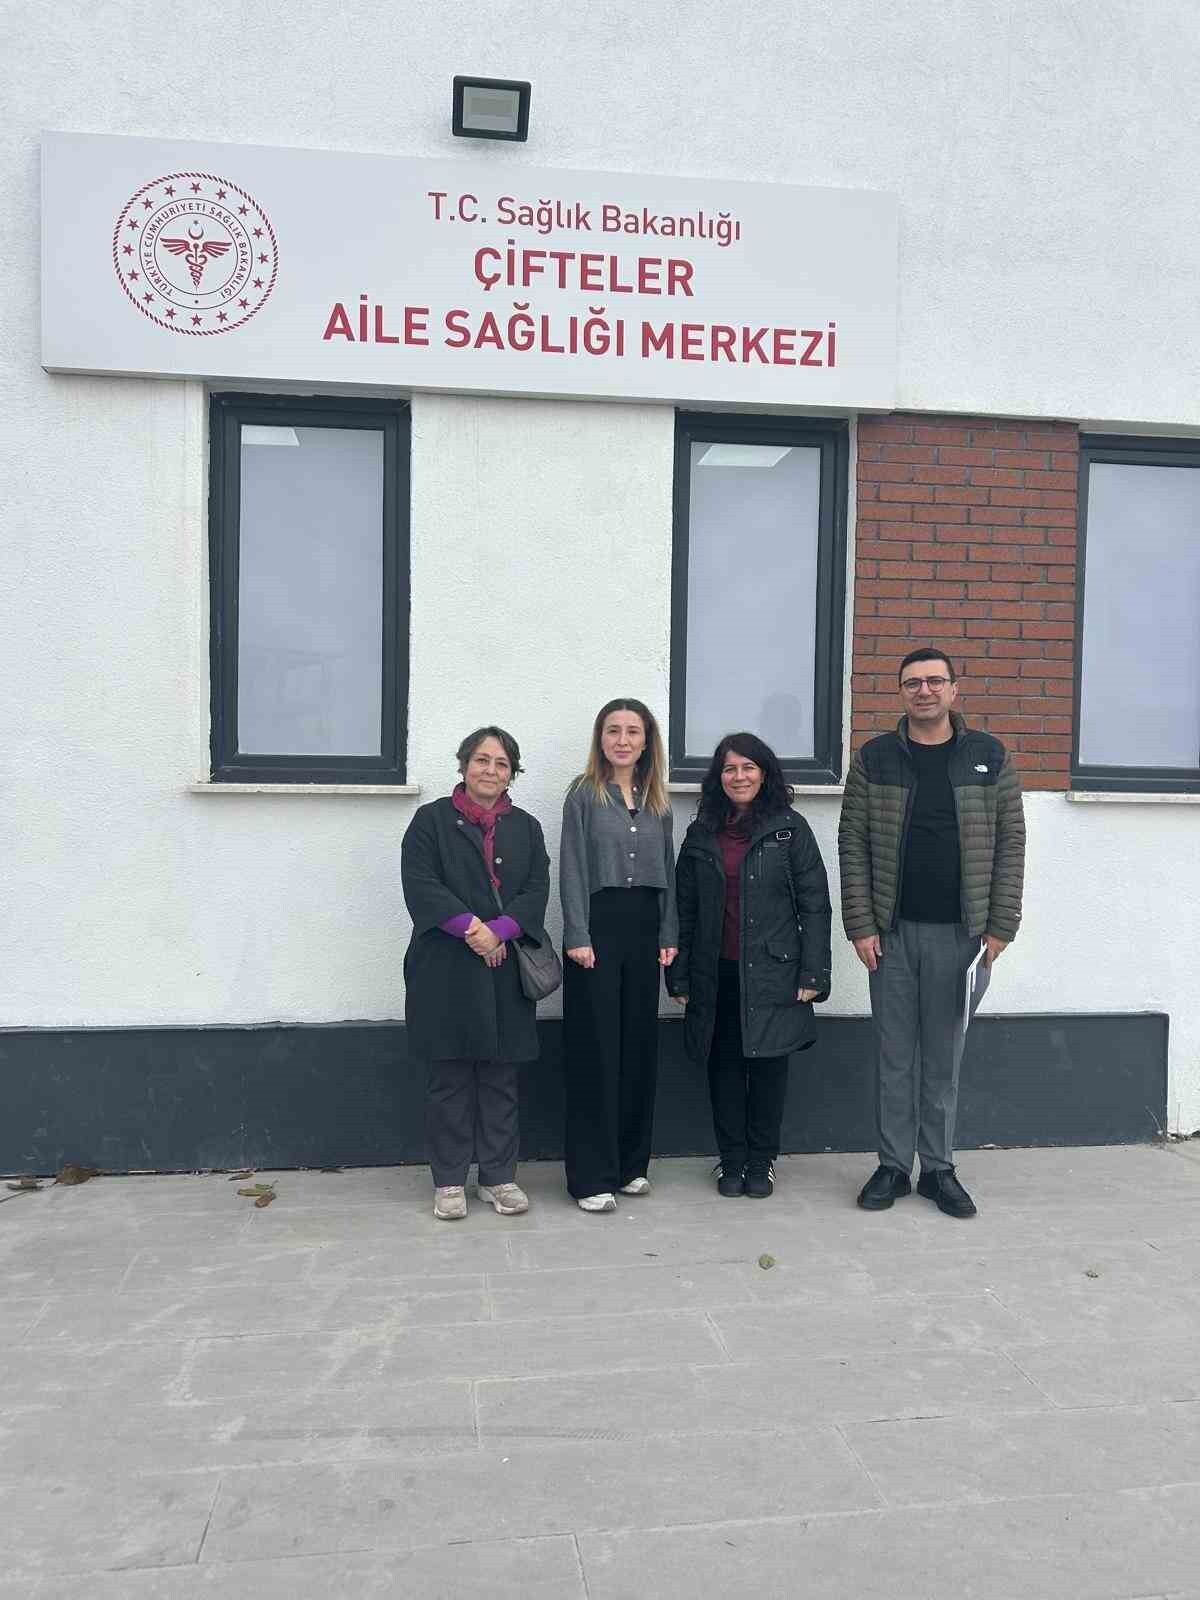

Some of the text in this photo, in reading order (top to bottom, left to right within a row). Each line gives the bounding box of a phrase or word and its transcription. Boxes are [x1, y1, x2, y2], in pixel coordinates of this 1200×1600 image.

[428, 192, 741, 246] T.C. Sağlık Bakanlığı
[474, 239, 694, 296] ÇİFTELER
[323, 294, 837, 368] AİLE SAĞLIĞI MERKEZİ
